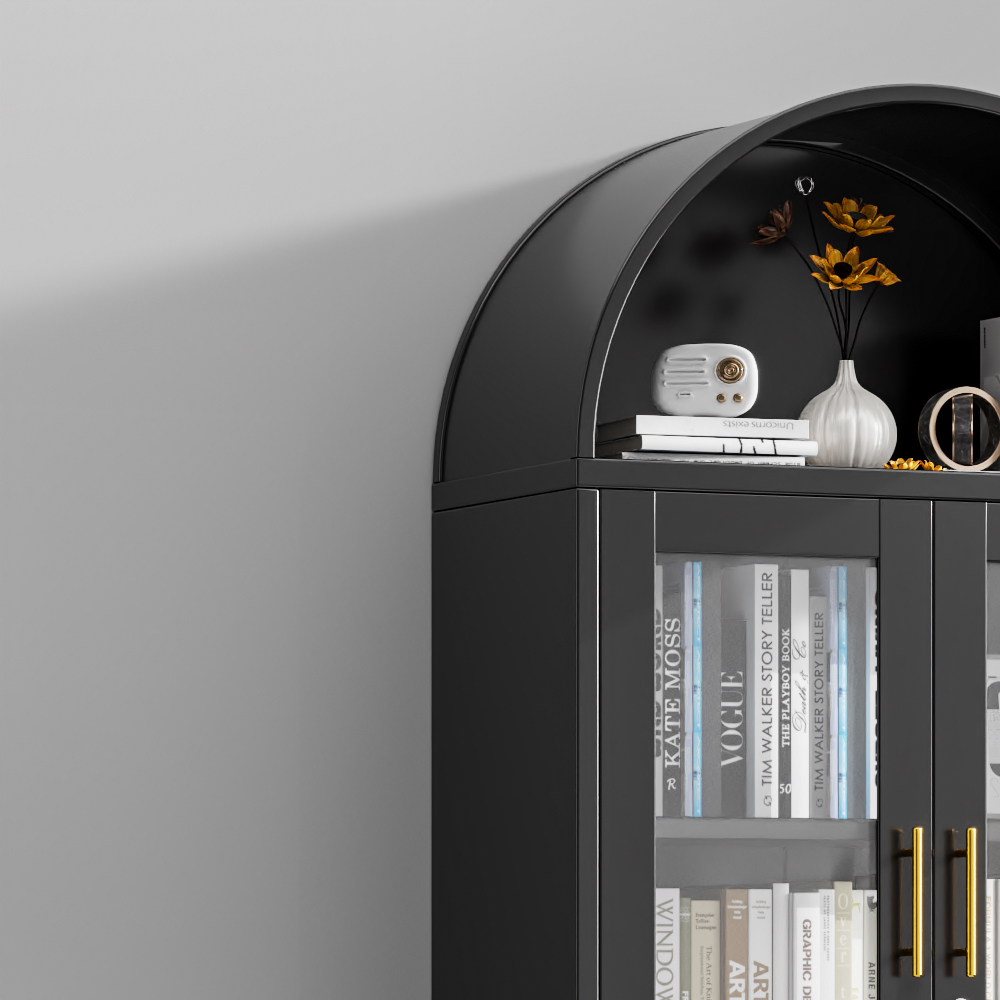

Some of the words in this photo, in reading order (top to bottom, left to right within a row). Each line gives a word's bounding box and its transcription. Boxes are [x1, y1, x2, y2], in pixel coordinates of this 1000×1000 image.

[723, 420, 750, 429] exists
[751, 420, 794, 430] Unicorns
[761, 572, 773, 625] TELLER
[664, 618, 681, 690] MOSS
[761, 630, 773, 682] STORY
[781, 628, 791, 662] BOOK
[814, 613, 824, 656] TELLER
[781, 664, 791, 721] PLAYBOY
[814, 661, 824, 704] STORY
[664, 698, 681, 769] KATE
[720, 671, 744, 767] VOGUE
[761, 687, 773, 753] WALKER
[781, 723, 791, 749] THE
[814, 708, 824, 764] WALKER
[761, 760, 773, 787] TIM
[779, 783, 792, 795] 50
[814, 768, 824, 791] TIM
[705, 946, 713, 961] The
[802, 918, 812, 981] GRAPHIC
[705, 977, 713, 986] of
[867, 962, 877, 990] ARNE
